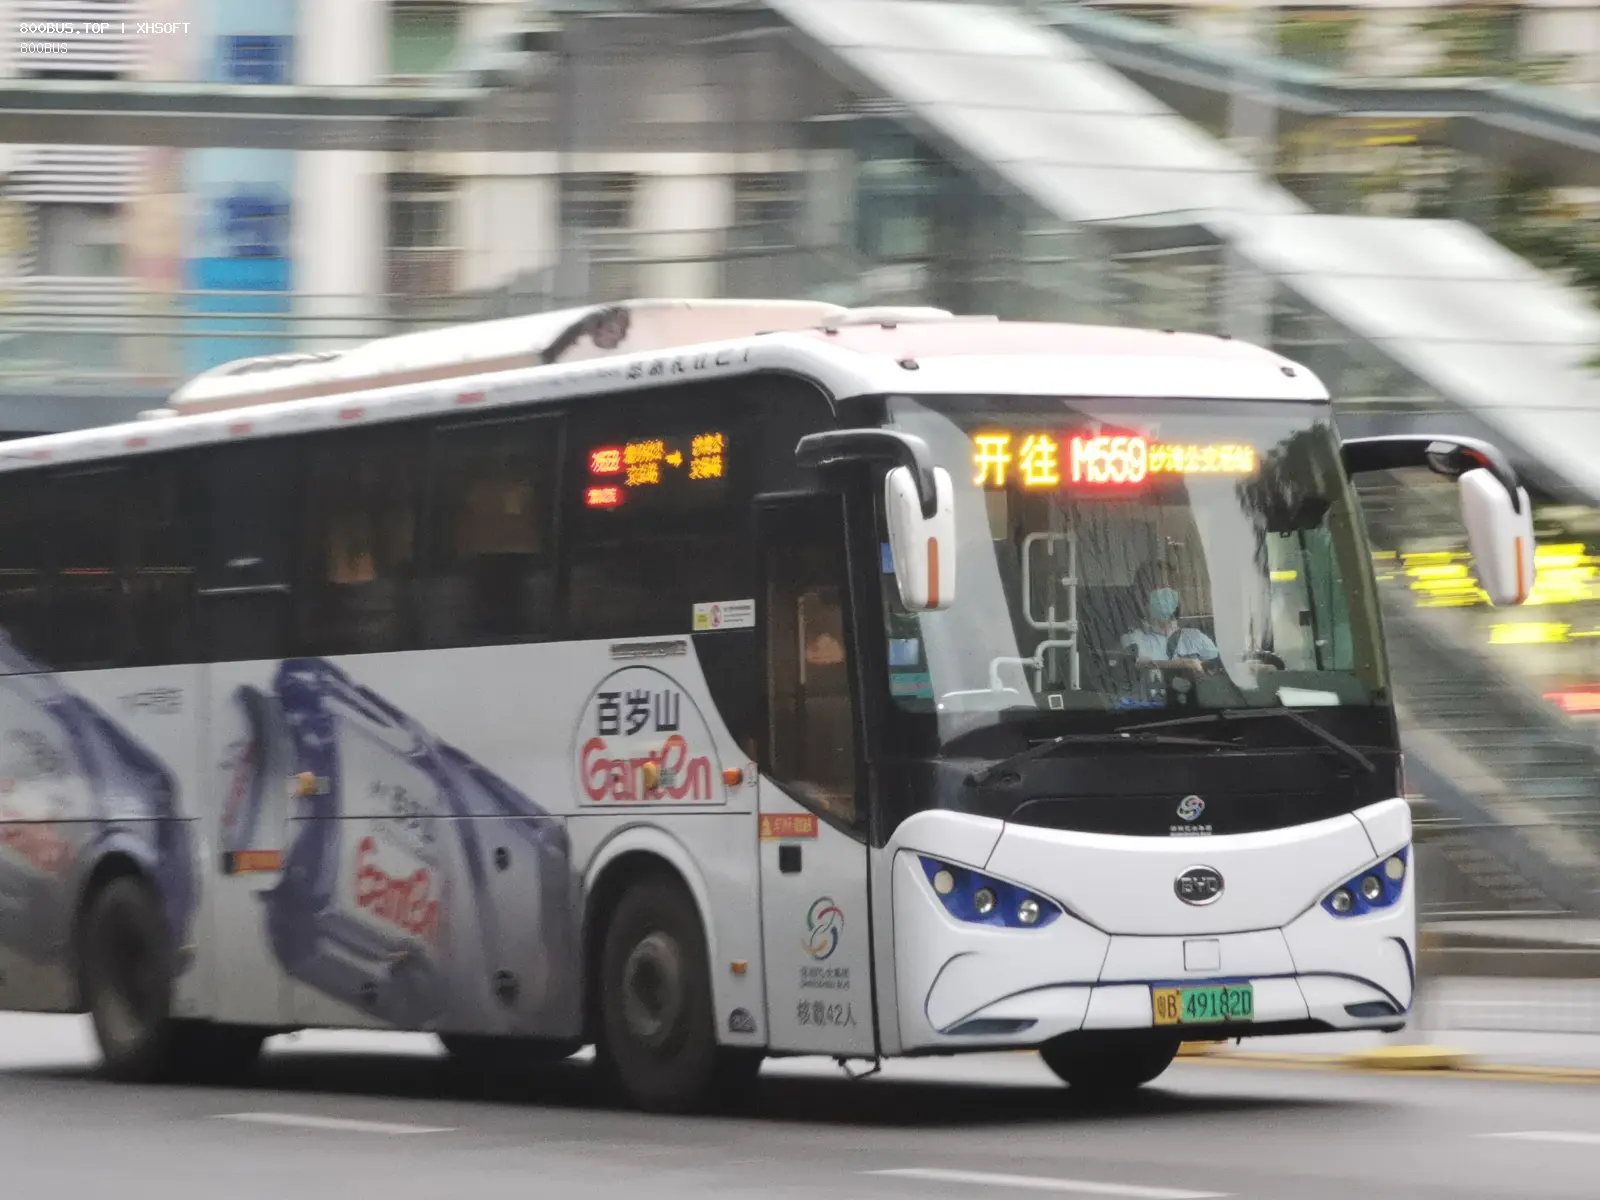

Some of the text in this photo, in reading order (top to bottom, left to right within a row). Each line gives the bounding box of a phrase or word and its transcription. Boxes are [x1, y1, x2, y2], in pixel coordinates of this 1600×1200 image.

[973, 434, 1058, 486] 开往
[1069, 435, 1149, 484] M559
[597, 689, 681, 736] 百岁山
[1181, 876, 1217, 894] BYD
